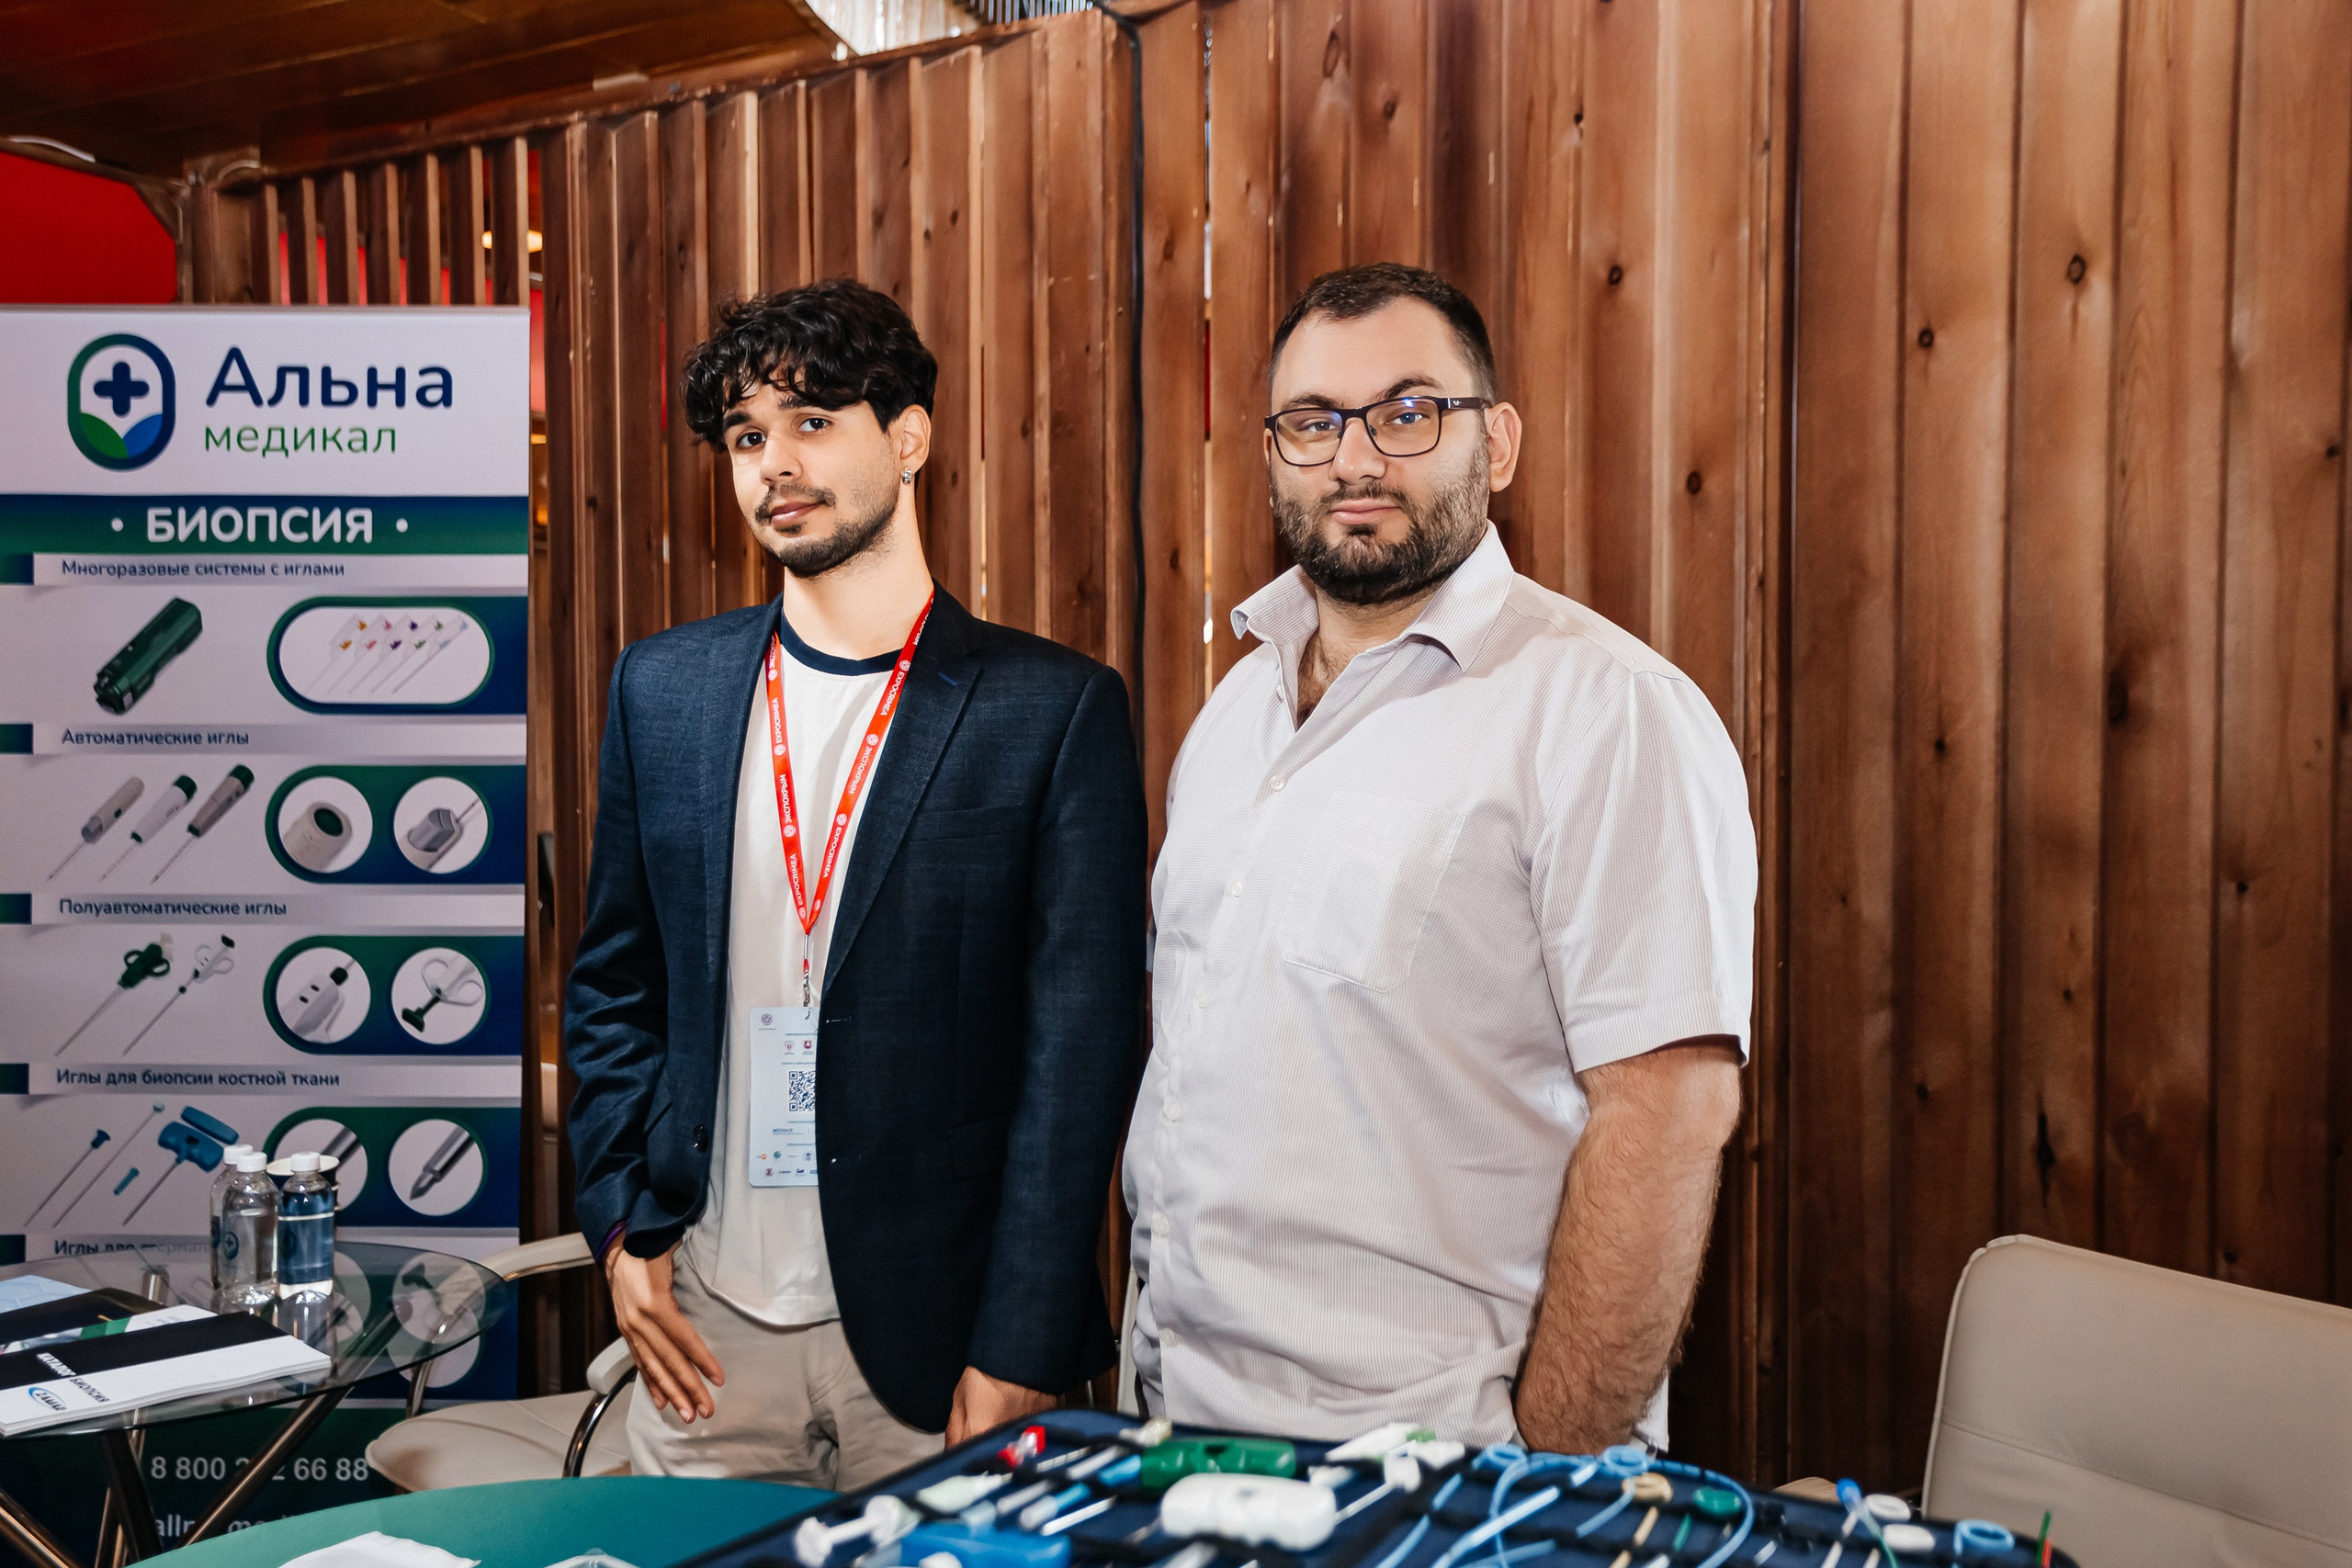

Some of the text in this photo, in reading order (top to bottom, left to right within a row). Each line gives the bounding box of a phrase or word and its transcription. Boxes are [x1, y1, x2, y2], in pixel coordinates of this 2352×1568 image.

[205, 346, 453, 408] Альна
[204, 425, 396, 458] медикал
[147, 505, 373, 544] БИОПСИЯ
[62, 559, 345, 579] Многоразовые системы с иглами
[880, 671, 906, 716] EXPOCRIMEA
[62, 728, 249, 745] Автоматические иглы
[772, 697, 783, 744] EXPOCRIMEA
[849, 746, 873, 795] ЭКСПОКРЫМ
[780, 774, 792, 824] ЭКСПОКРЫМ
[823, 827, 842, 878] EXPOCRIMEA
[790, 853, 803, 906] EXPOCRIMEA
[60, 898, 287, 918] Полуавтоматические иглы
[56, 1069, 340, 1086] Иглы для биопсии костной ткани
[54, 1240, 99, 1255] Иглы
[151, 1456, 167, 1480] 8
[175, 1457, 226, 1480] 800
[294, 1458, 327, 1481] 66
[335, 1458, 368, 1481] 88
